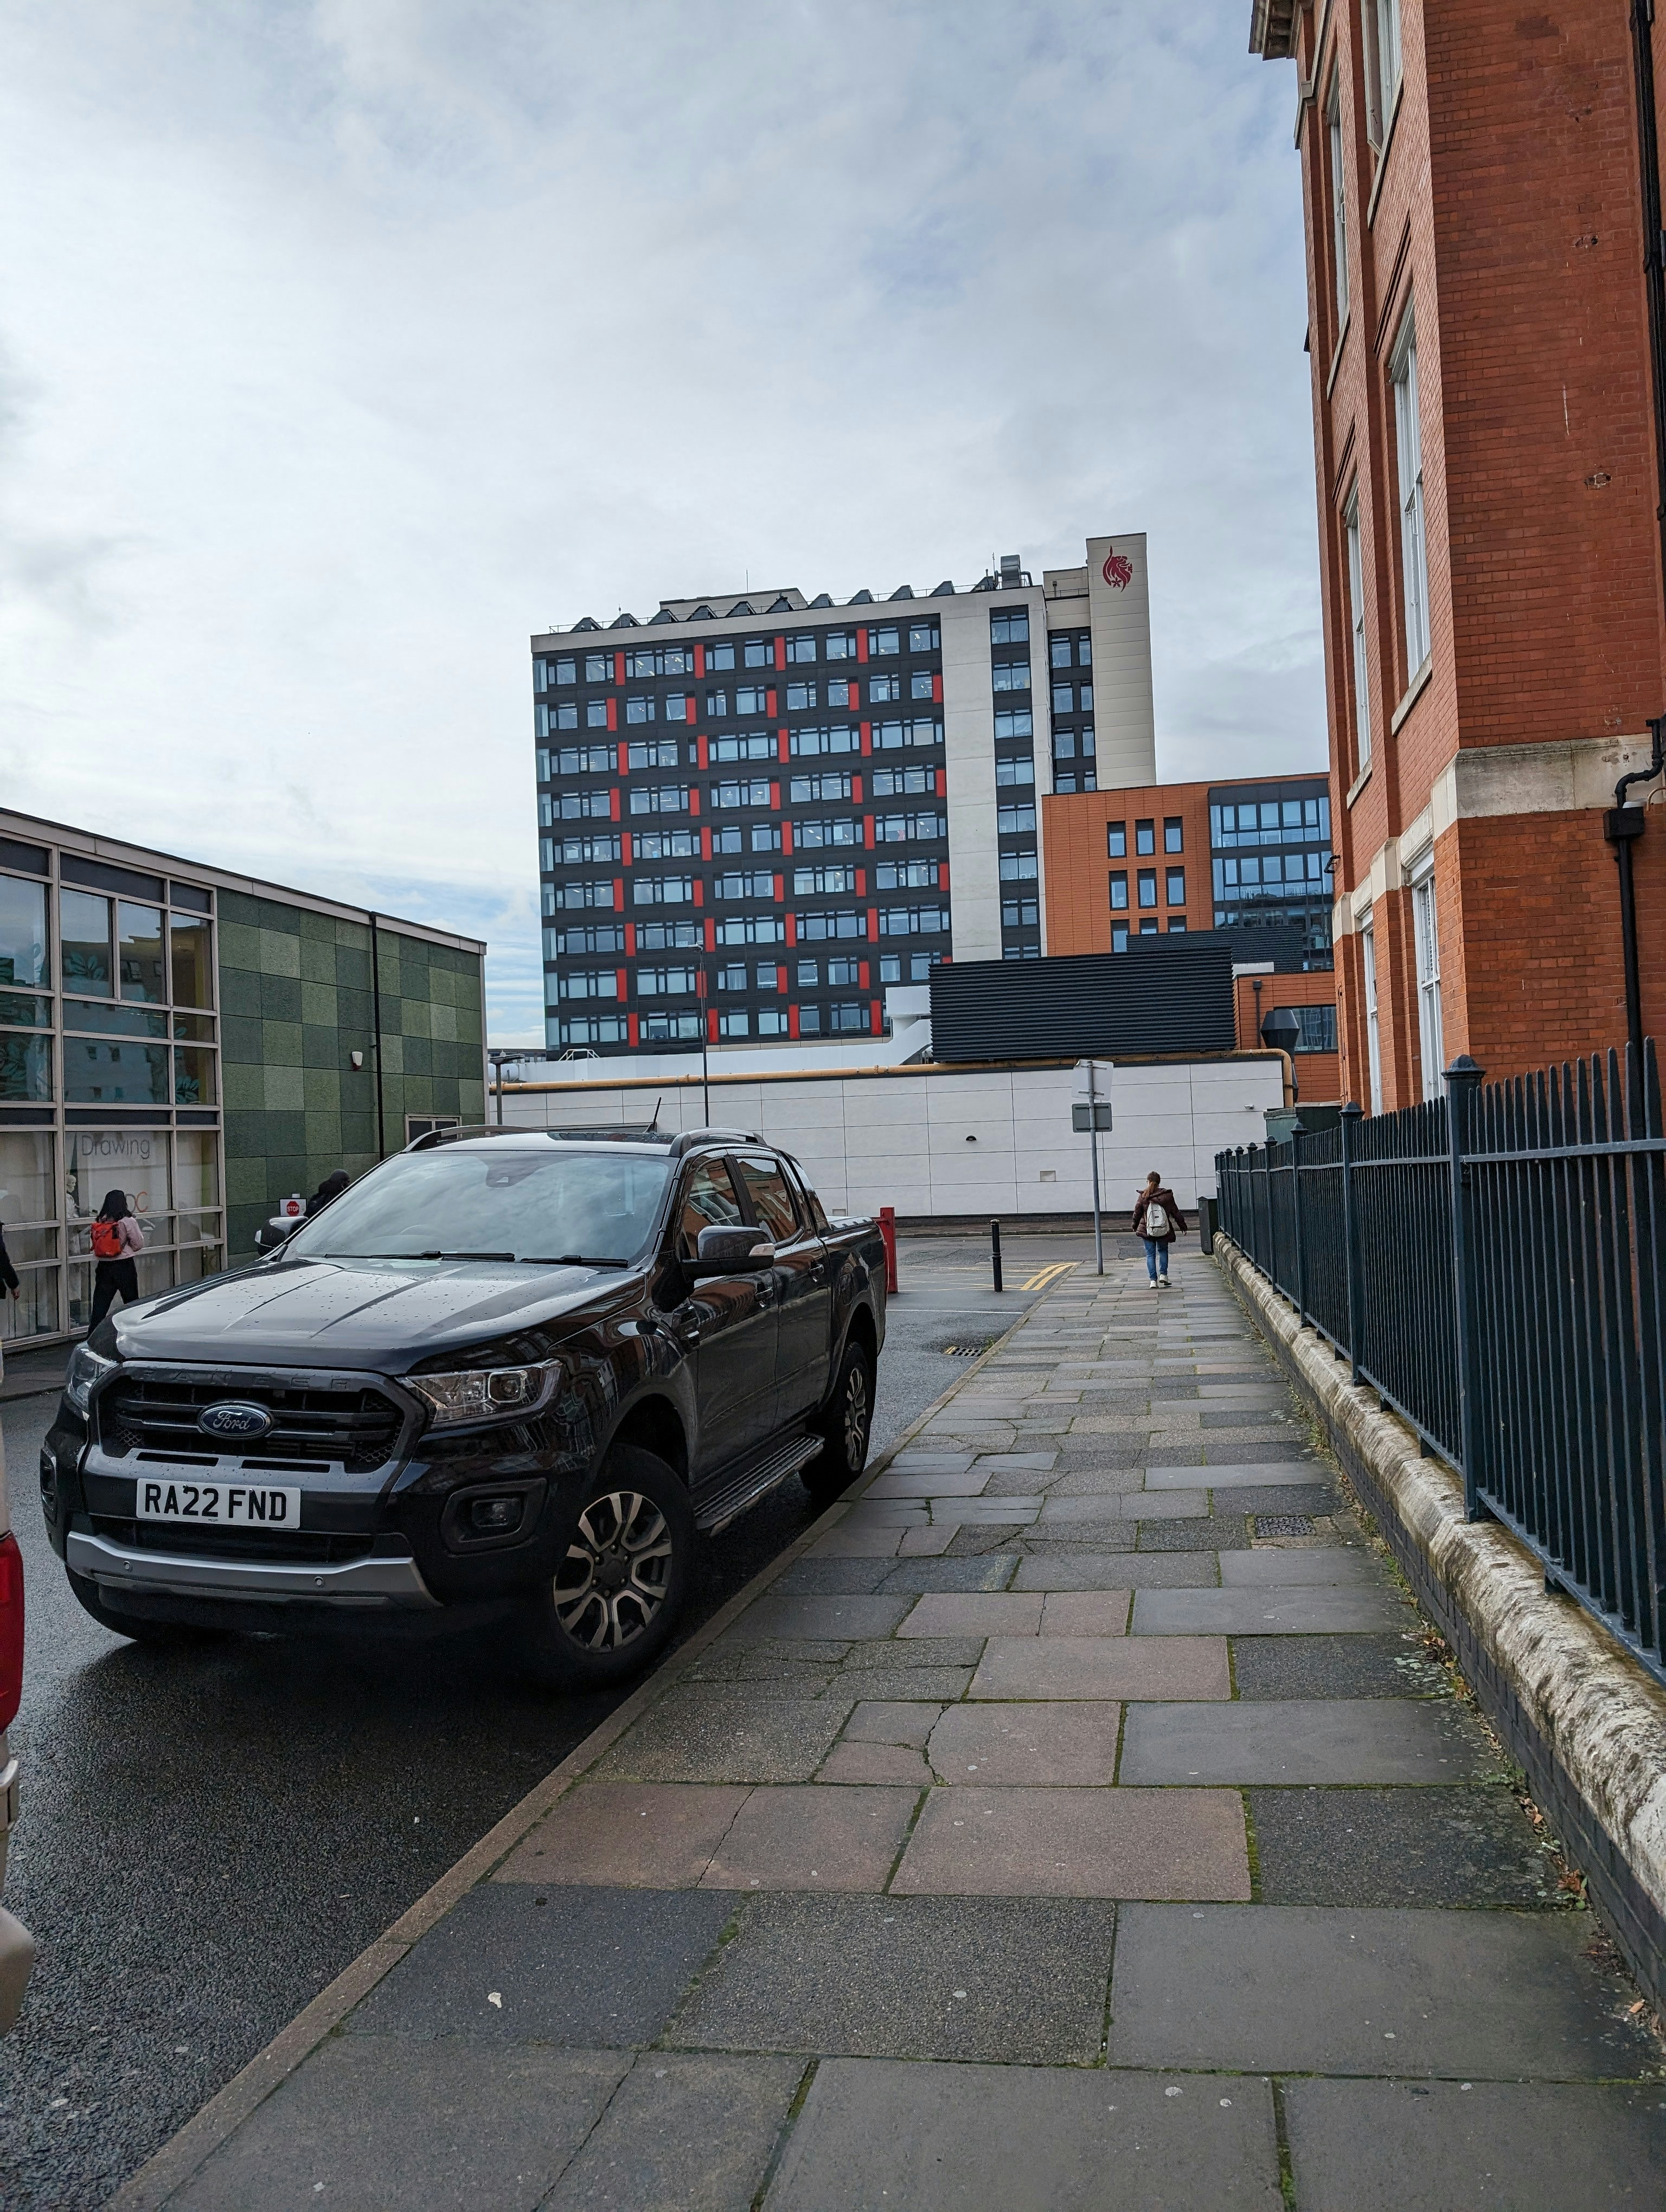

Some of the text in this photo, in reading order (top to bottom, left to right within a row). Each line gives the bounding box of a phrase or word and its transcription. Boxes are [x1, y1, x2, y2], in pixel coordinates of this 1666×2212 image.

[81, 1135, 150, 1160] Drawing
[139, 1369, 351, 1390] RANGER
[213, 1411, 252, 1430] Ford
[145, 1483, 287, 1521] RA22 FND
